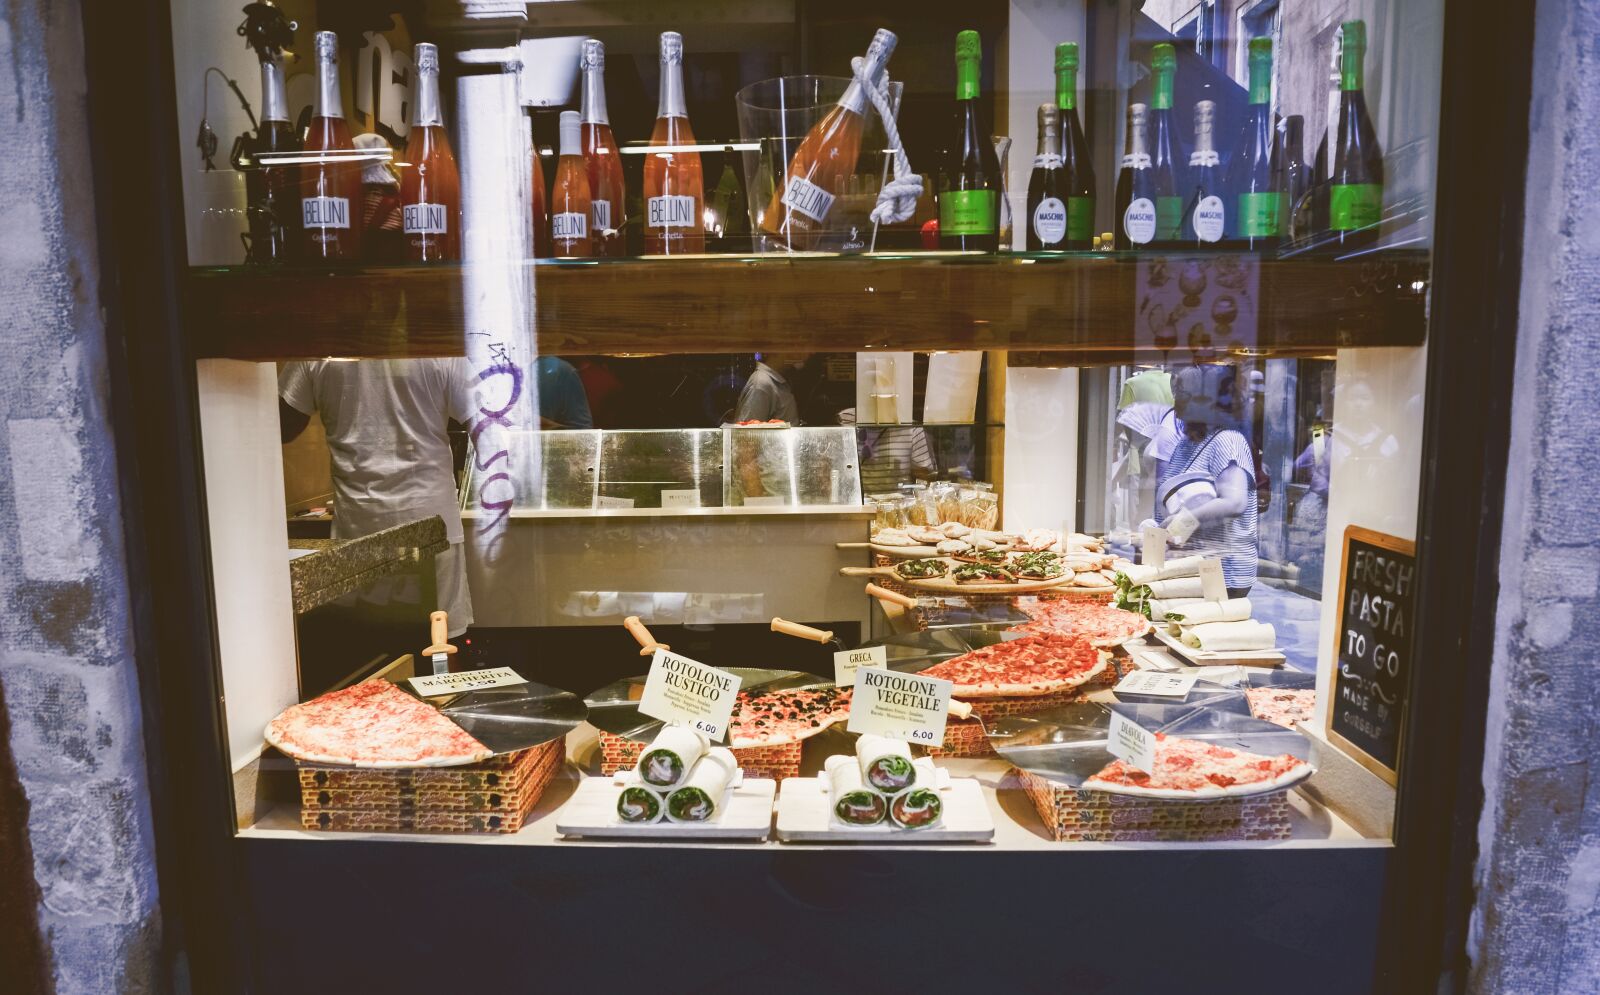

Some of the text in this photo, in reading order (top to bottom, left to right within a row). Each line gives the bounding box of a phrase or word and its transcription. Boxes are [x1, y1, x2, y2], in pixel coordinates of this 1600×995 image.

[652, 199, 690, 223] BELLINI
[788, 180, 831, 218] BELLINI
[305, 200, 345, 224] BELLINI
[405, 207, 442, 230] BELLINI
[553, 216, 583, 236] BELLINI
[1353, 551, 1413, 597] FRESH
[1350, 589, 1404, 638] PASTA
[849, 652, 872, 663] GRECA
[1347, 630, 1399, 678] TO GO
[422, 672, 512, 687] MARGHERITA
[661, 656, 732, 692] ROTOLONE
[865, 672, 937, 697] ROTOLONE
[664, 672, 720, 701] RUSTICO
[877, 689, 941, 712] VEGETALE
[1343, 686, 1369, 712] MADE
[1121, 721, 1146, 745] DIAVOLA
